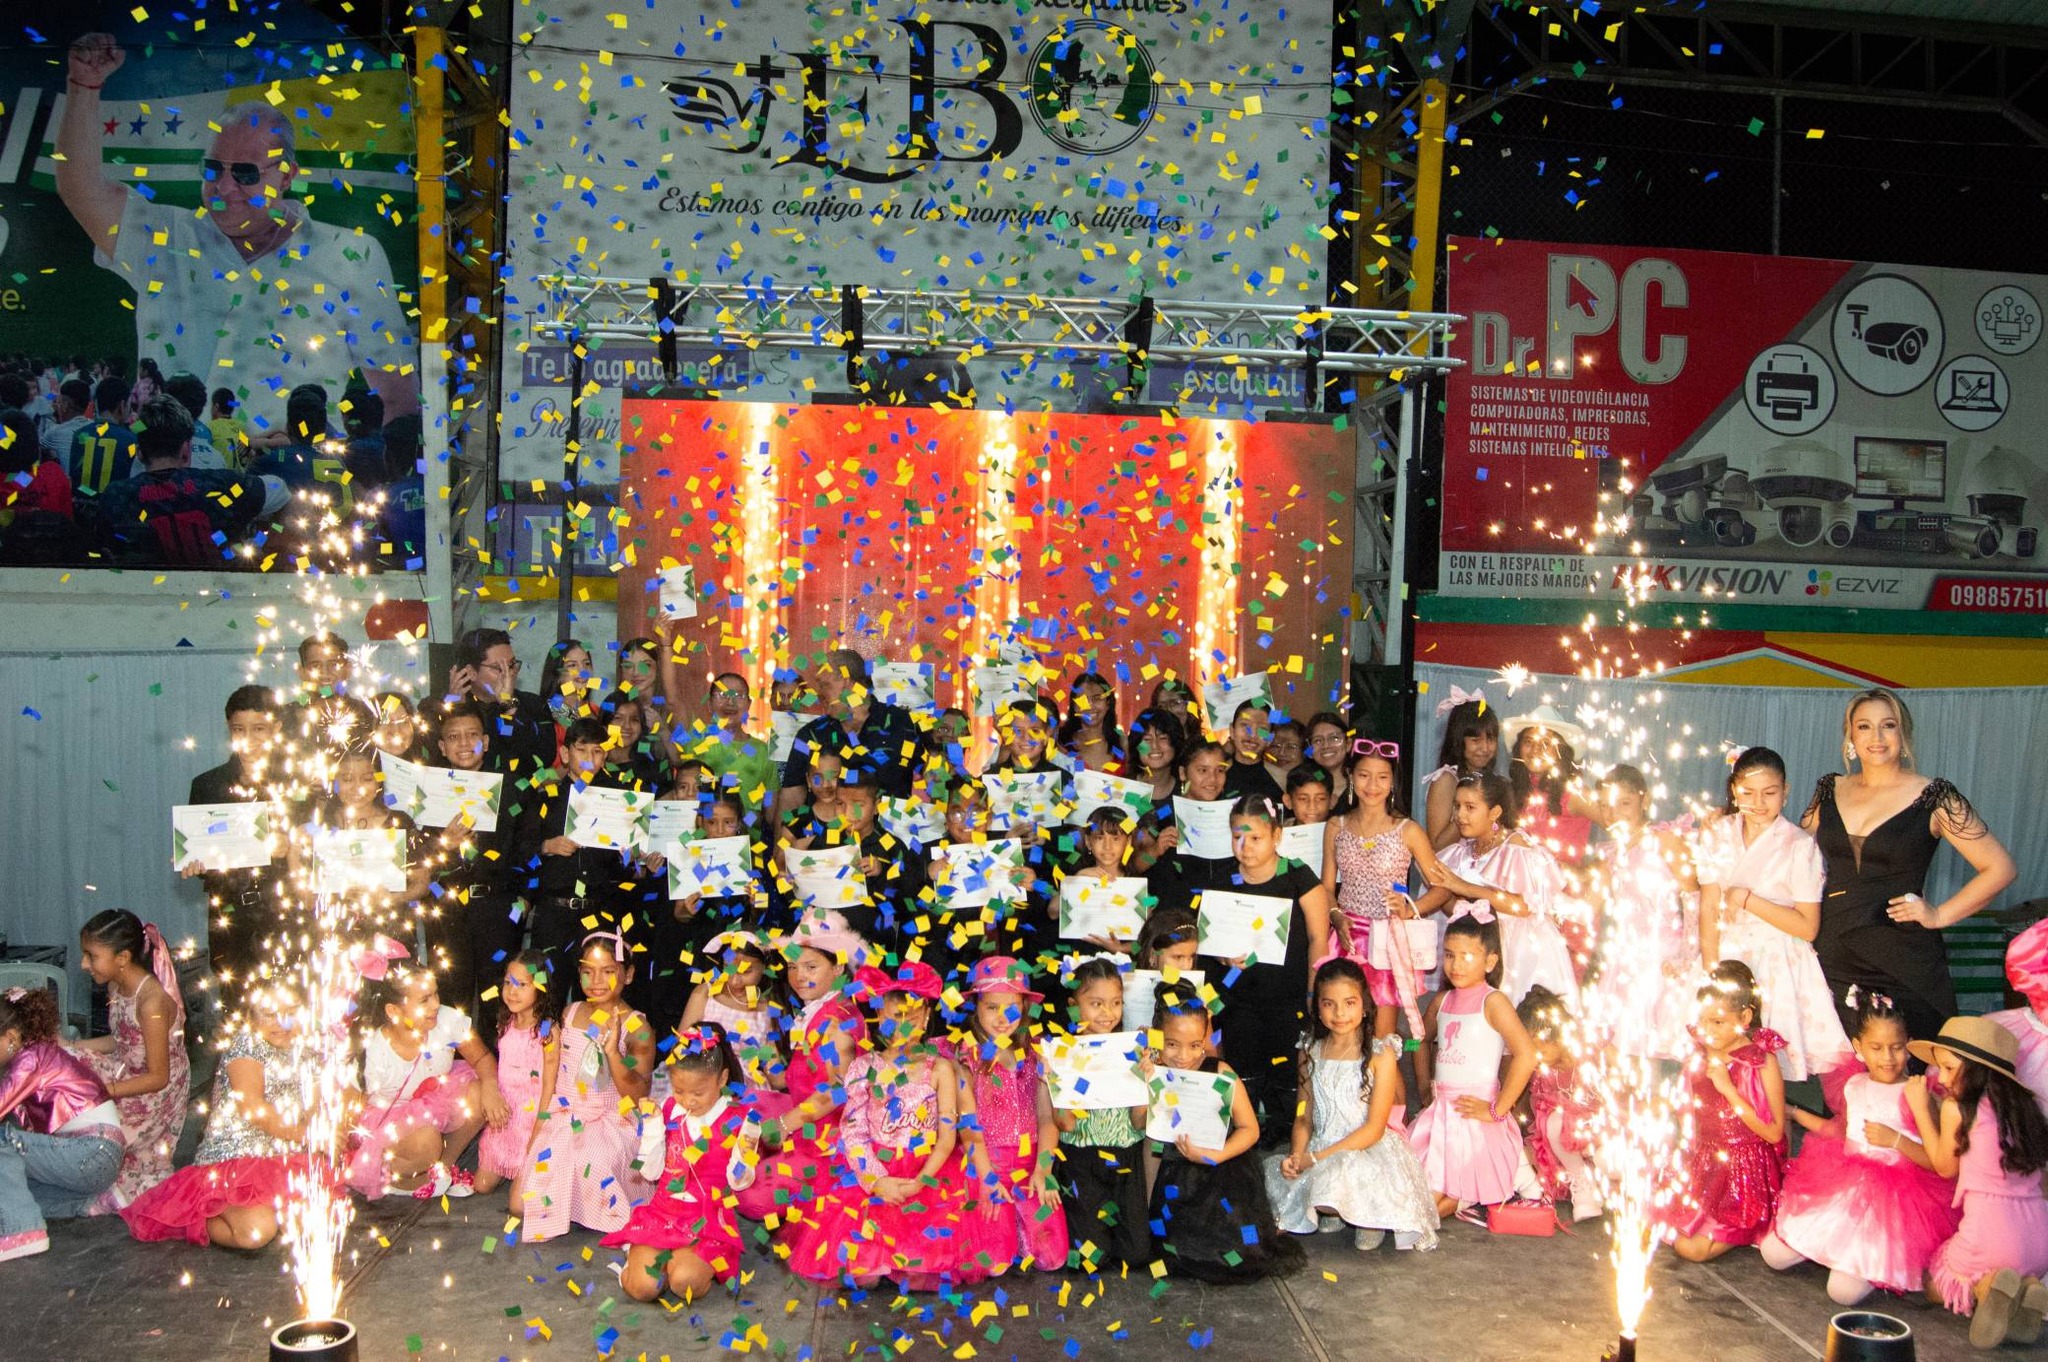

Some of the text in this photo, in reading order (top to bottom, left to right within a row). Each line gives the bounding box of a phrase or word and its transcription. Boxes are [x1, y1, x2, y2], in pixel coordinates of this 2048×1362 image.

[1472, 253, 1690, 385] Dr. PC
[527, 352, 556, 380] Te
[1471, 386, 1650, 407] SISTEMAS DE VIDEOVIGILANCIA
[524, 397, 621, 439] Preenir
[1470, 404, 1651, 427] COMPUTADORAS, IMPRESORAS,
[1469, 422, 1610, 441] MANTENIMIENTO, REDES
[1469, 439, 1527, 455] SISTEMAS
[1450, 554, 1476, 569] CON
[1481, 556, 1495, 570] EL
[1569, 558, 1585, 572] DE
[1449, 571, 1598, 589] LAS MEJORES MARCAS
[1836, 577, 1900, 594] EZVIZ
